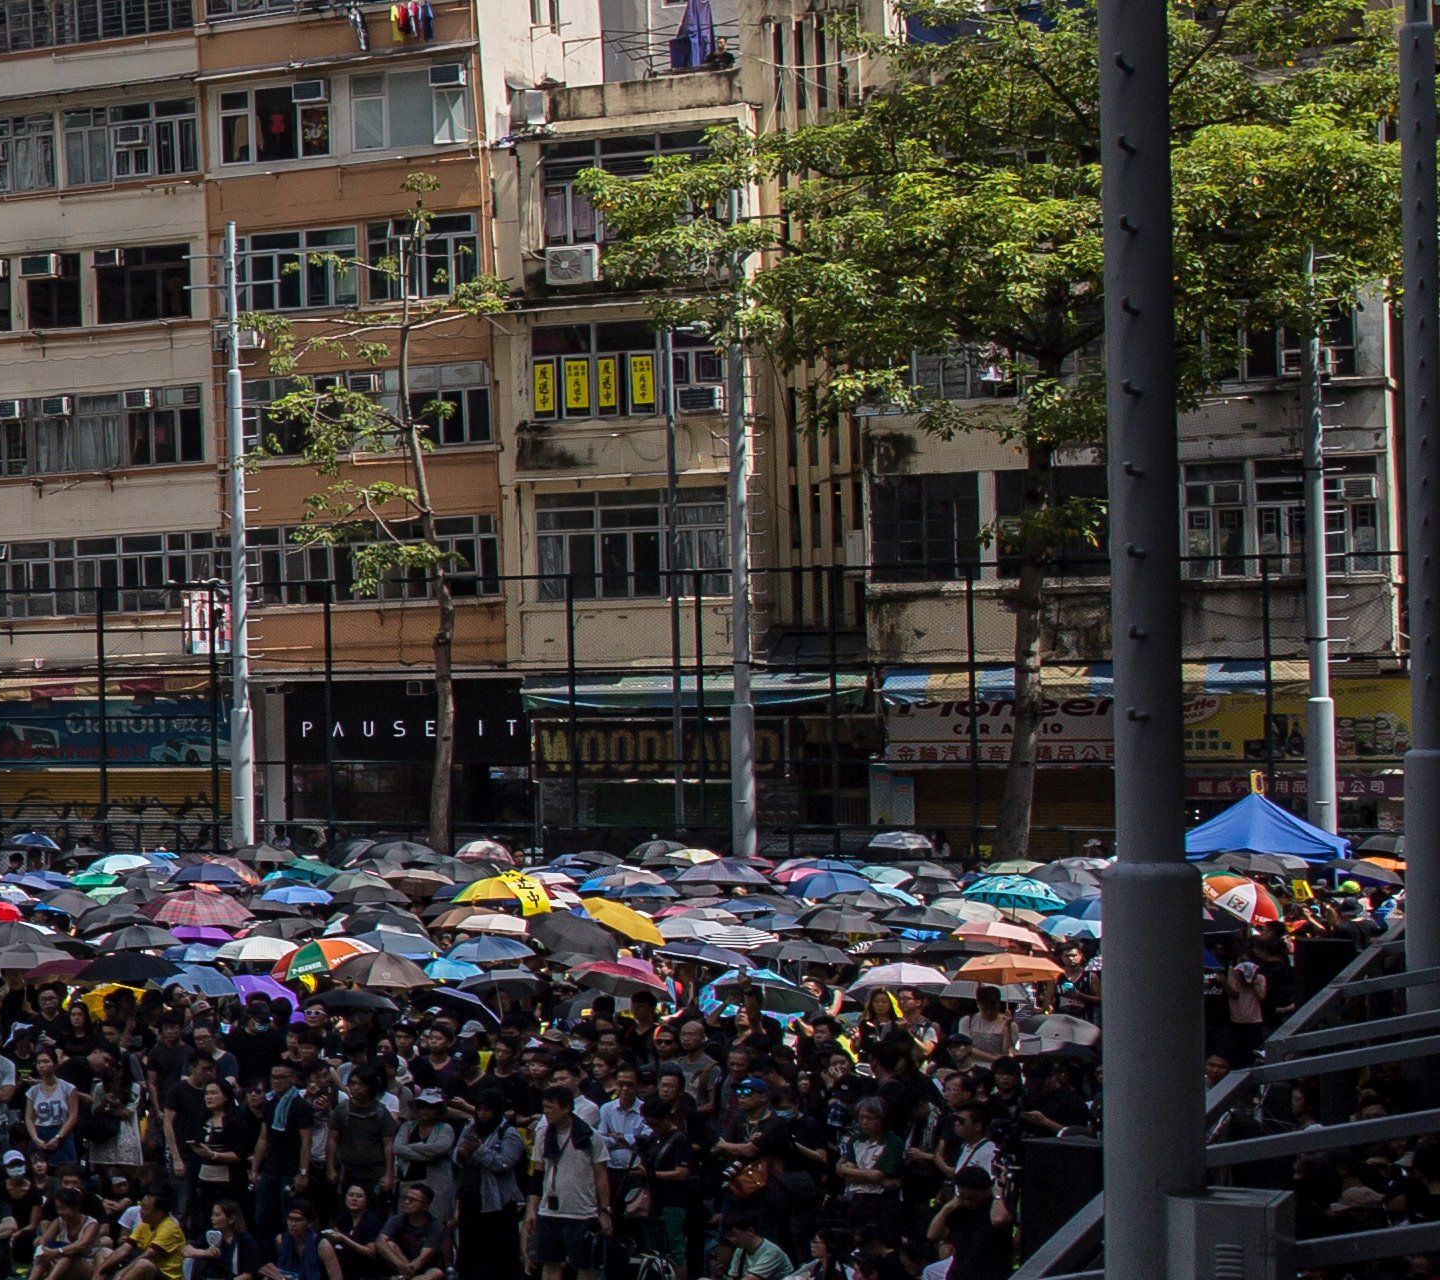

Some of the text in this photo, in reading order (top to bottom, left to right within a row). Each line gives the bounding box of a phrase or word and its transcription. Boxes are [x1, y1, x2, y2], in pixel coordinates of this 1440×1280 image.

[302, 720, 517, 737] PAUSE IT
[1001, 722, 1063, 734] AIO
